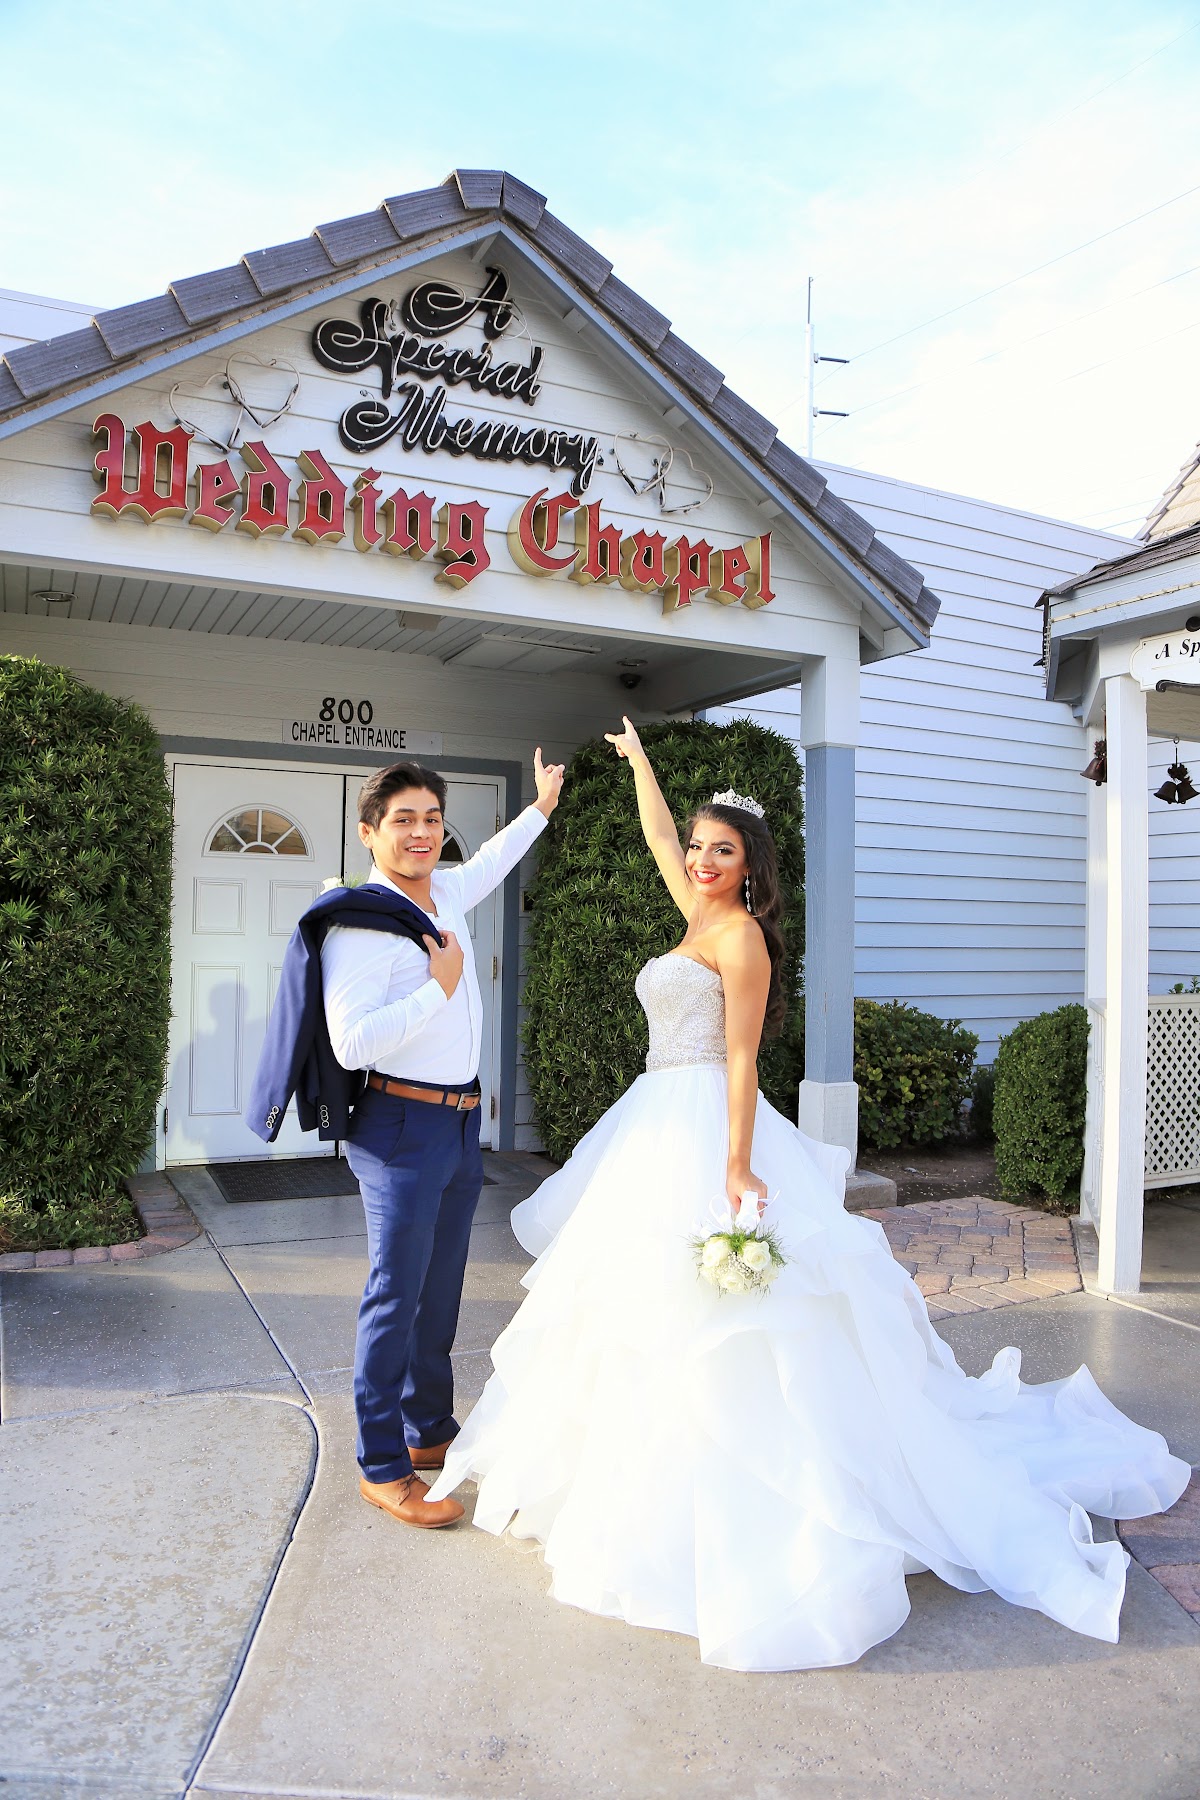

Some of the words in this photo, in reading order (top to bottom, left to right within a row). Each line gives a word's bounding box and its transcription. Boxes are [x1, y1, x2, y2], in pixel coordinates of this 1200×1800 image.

[402, 265, 514, 339] A
[312, 298, 545, 405] Special
[338, 381, 601, 497] Memory
[92, 414, 491, 589] Wedding
[508, 487, 776, 613] Chapel
[1155, 643, 1170, 660] A
[291, 721, 339, 744] CHAPEL
[345, 726, 406, 749] ENTRANCE
[319, 697, 373, 725] 800
